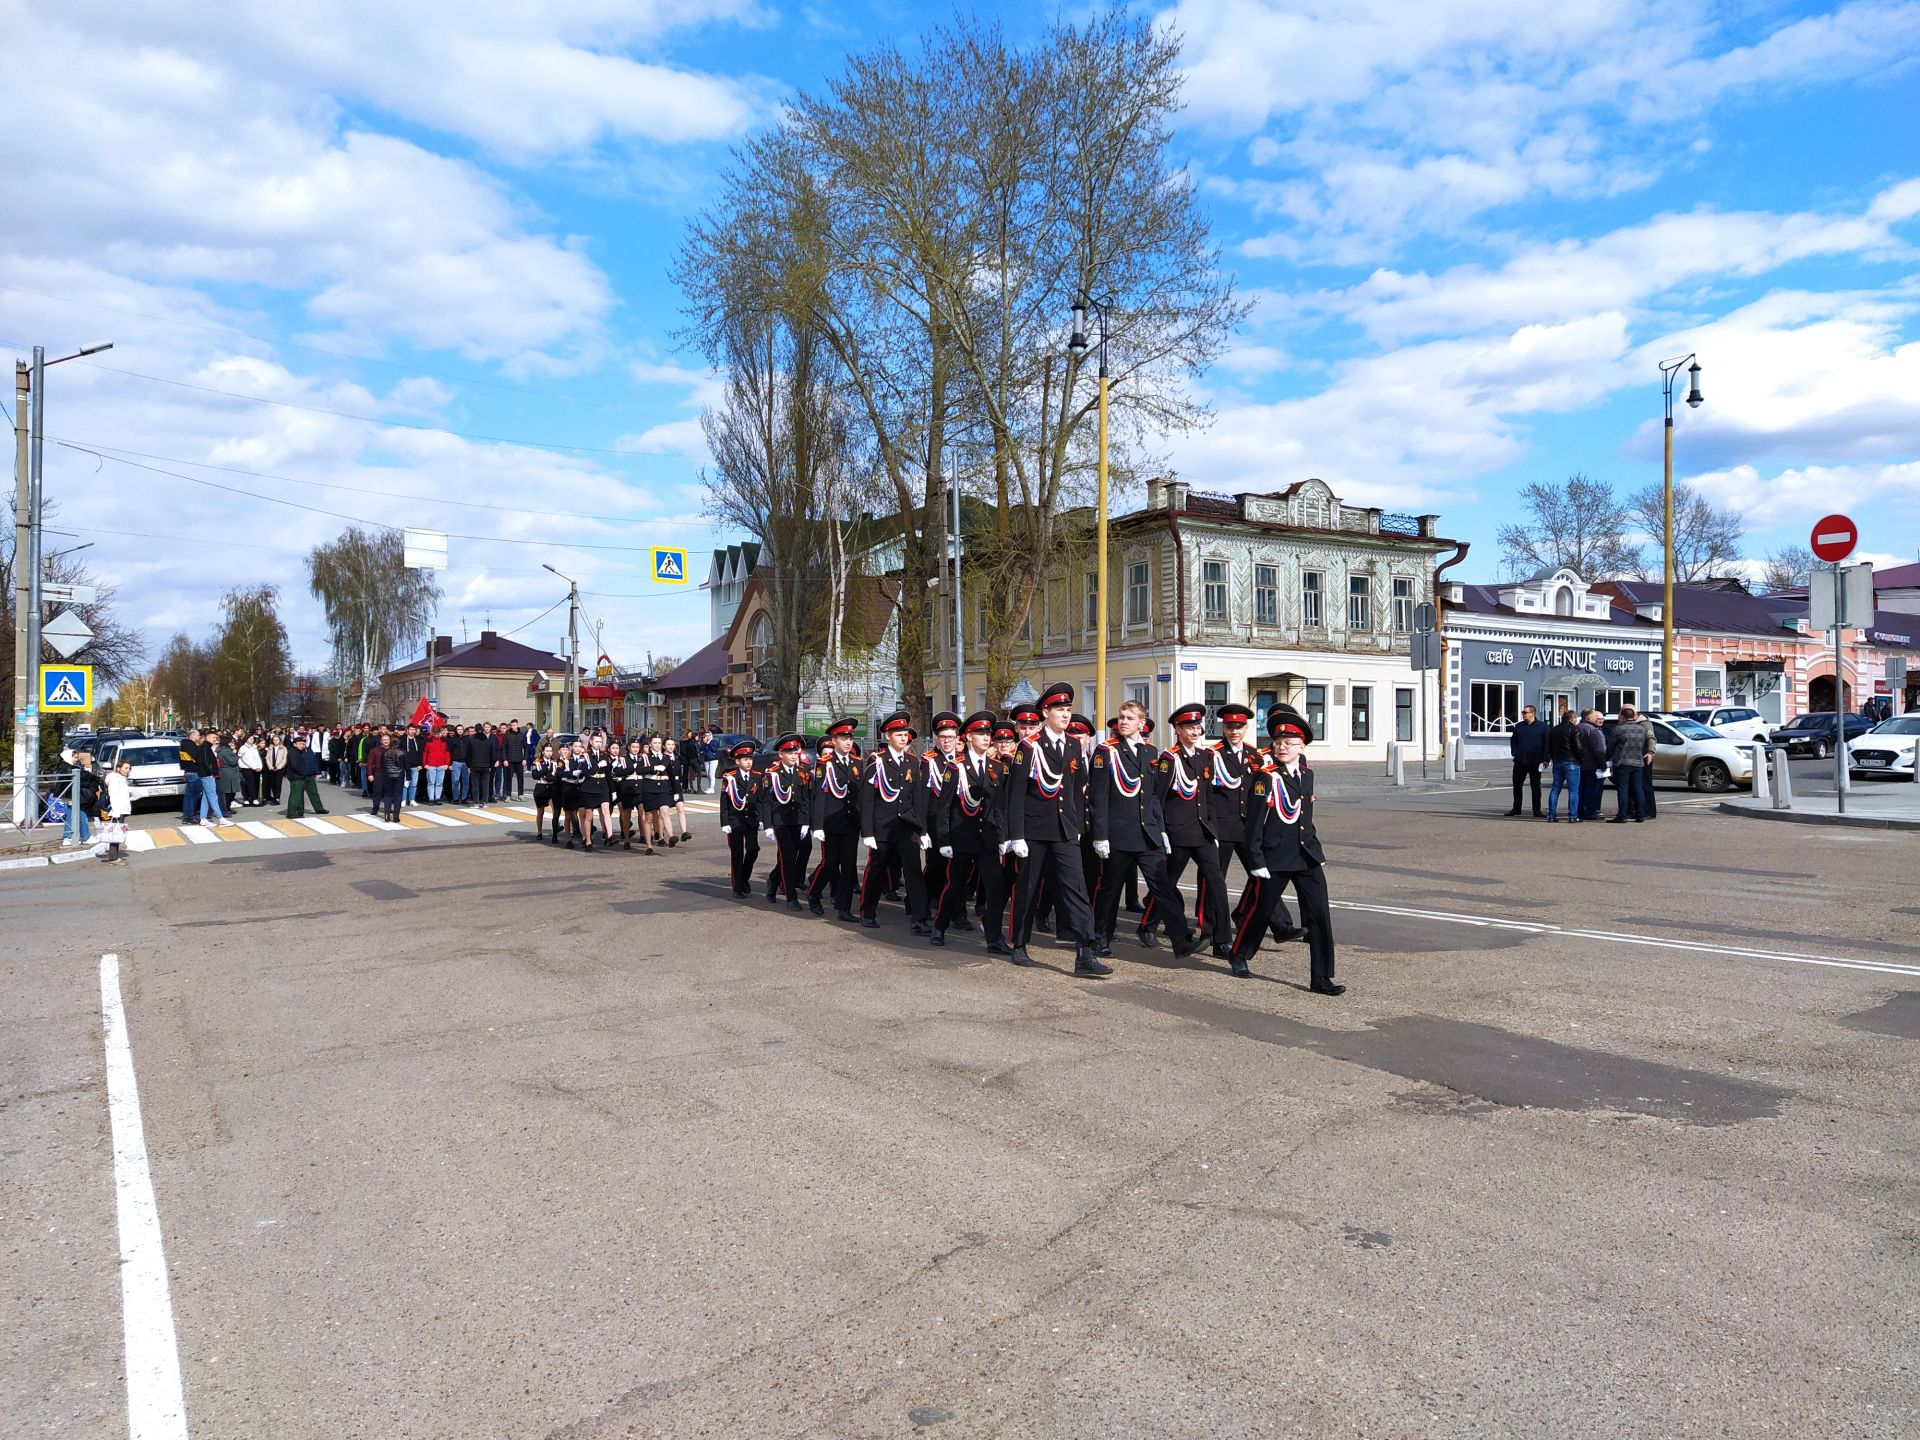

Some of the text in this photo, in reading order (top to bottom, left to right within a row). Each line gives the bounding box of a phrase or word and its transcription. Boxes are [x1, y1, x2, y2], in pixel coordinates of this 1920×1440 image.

[1485, 648, 1514, 664] café
[1526, 647, 1597, 673] AVENUE
[1605, 656, 1634, 674] кафе
[1696, 688, 1721, 698] АРЕНДА
